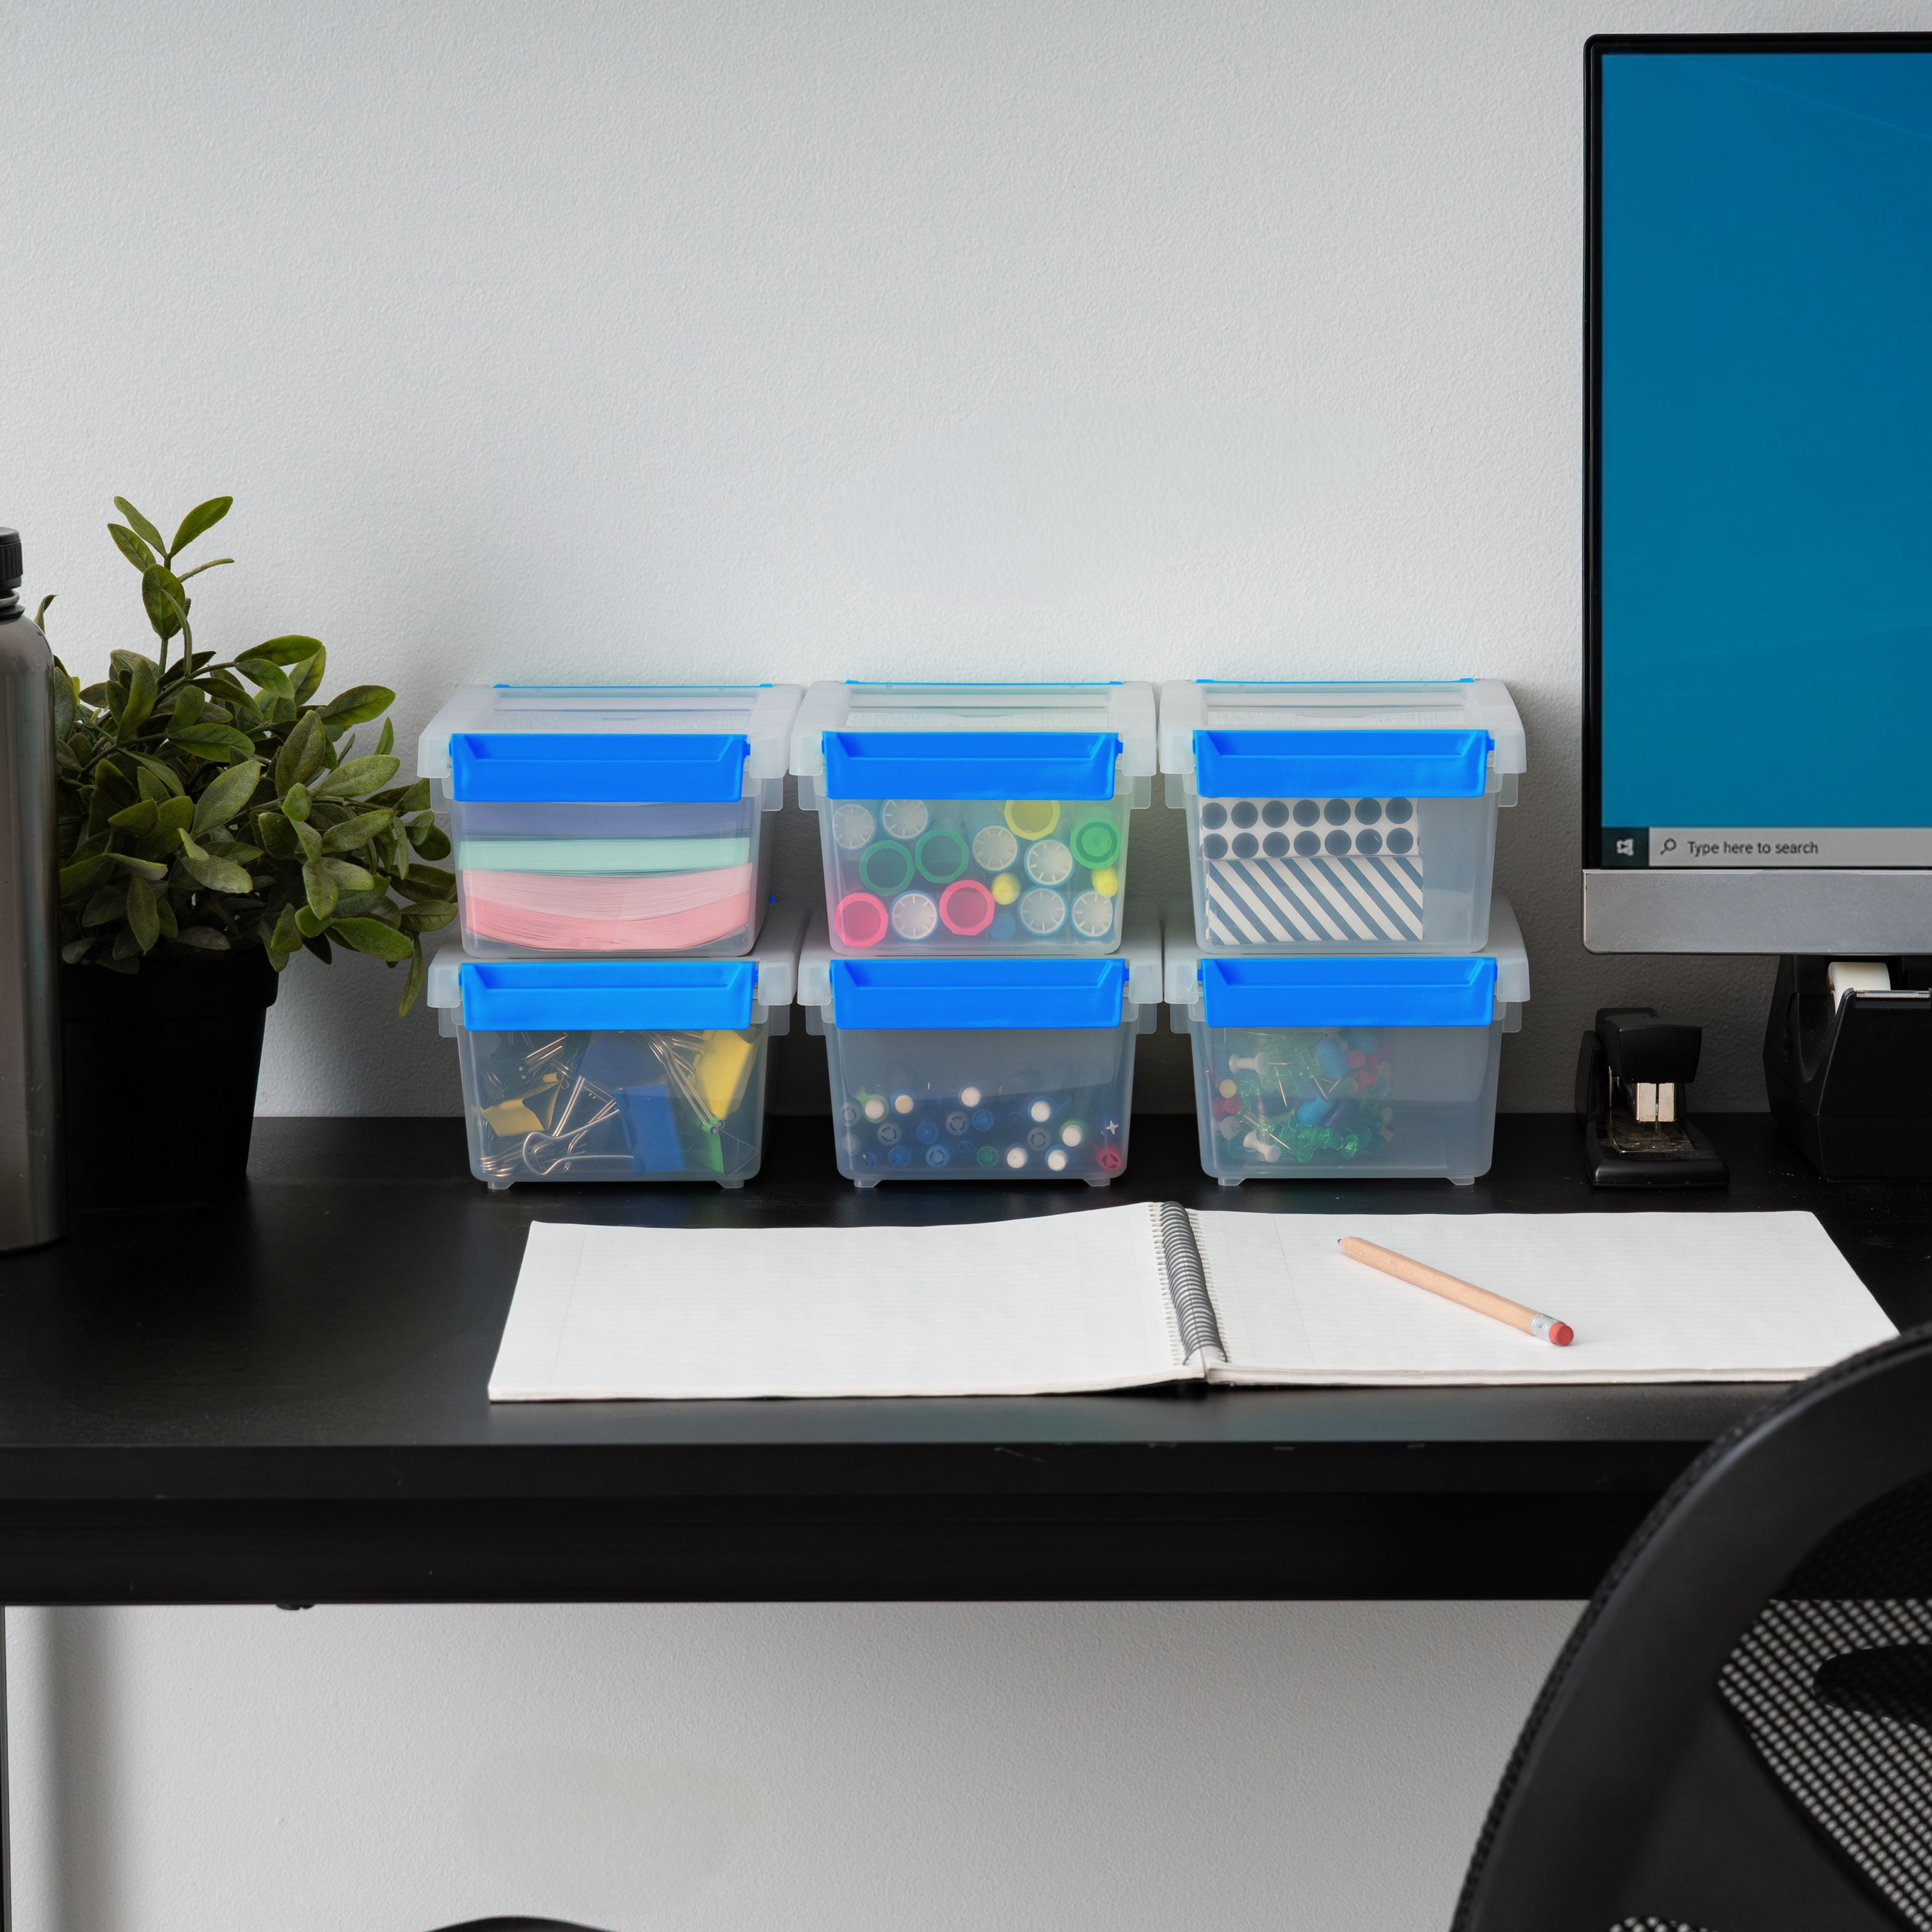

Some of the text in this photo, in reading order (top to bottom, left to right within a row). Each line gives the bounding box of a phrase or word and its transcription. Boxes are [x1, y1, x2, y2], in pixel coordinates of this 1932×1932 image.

[1687, 841, 1818, 857] Type here to search
